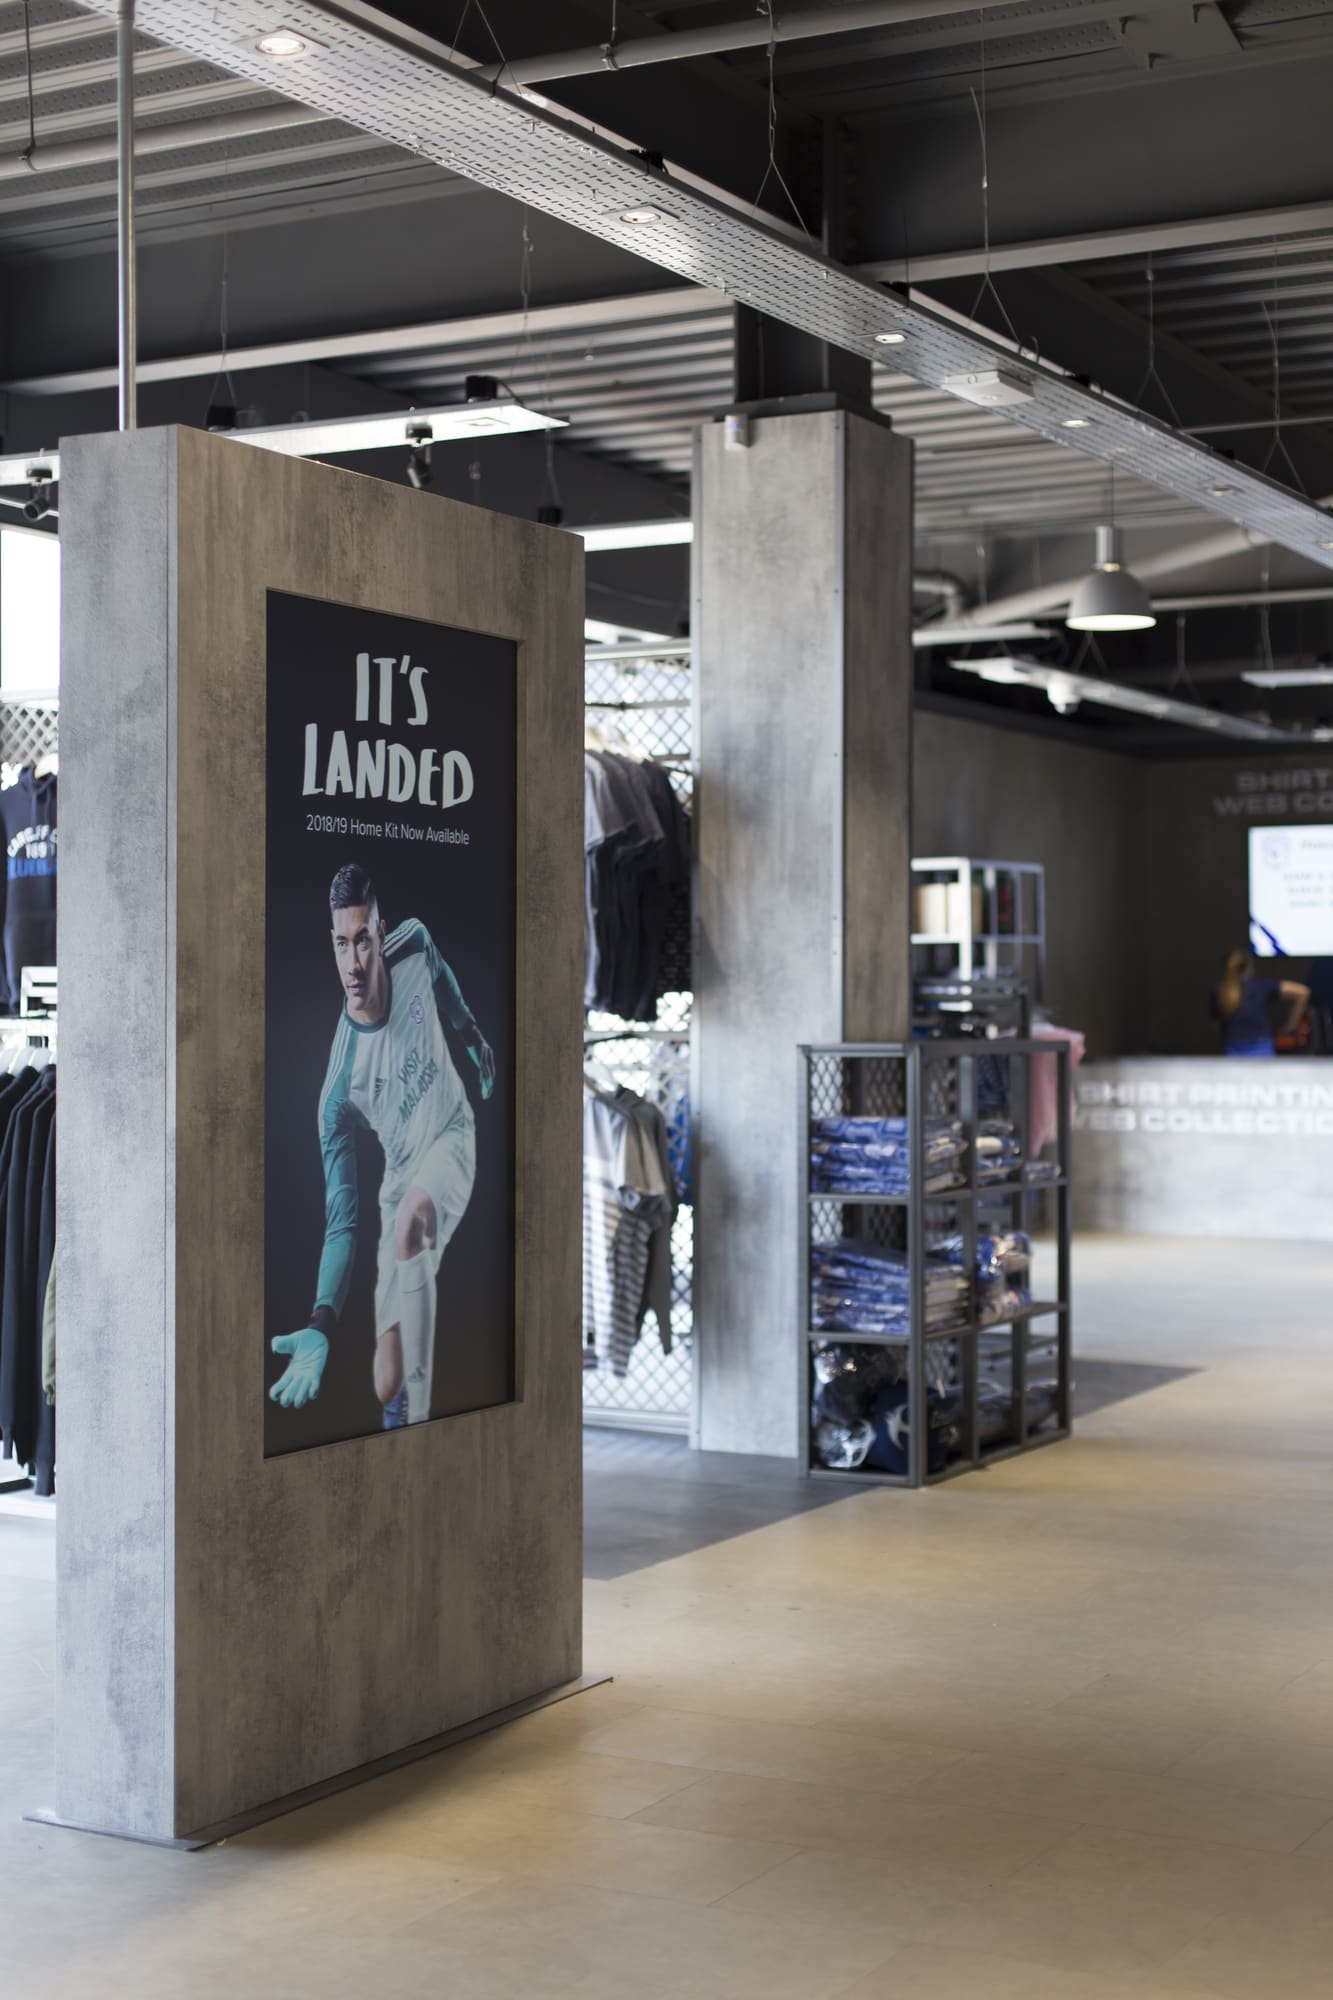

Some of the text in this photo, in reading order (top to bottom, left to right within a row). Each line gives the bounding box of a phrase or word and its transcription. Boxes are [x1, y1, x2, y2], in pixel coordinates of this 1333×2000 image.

[355, 652, 429, 727] IT'S
[302, 722, 474, 809] LANDED
[306, 813, 470, 845] 2018/19 Home Kit Now Available
